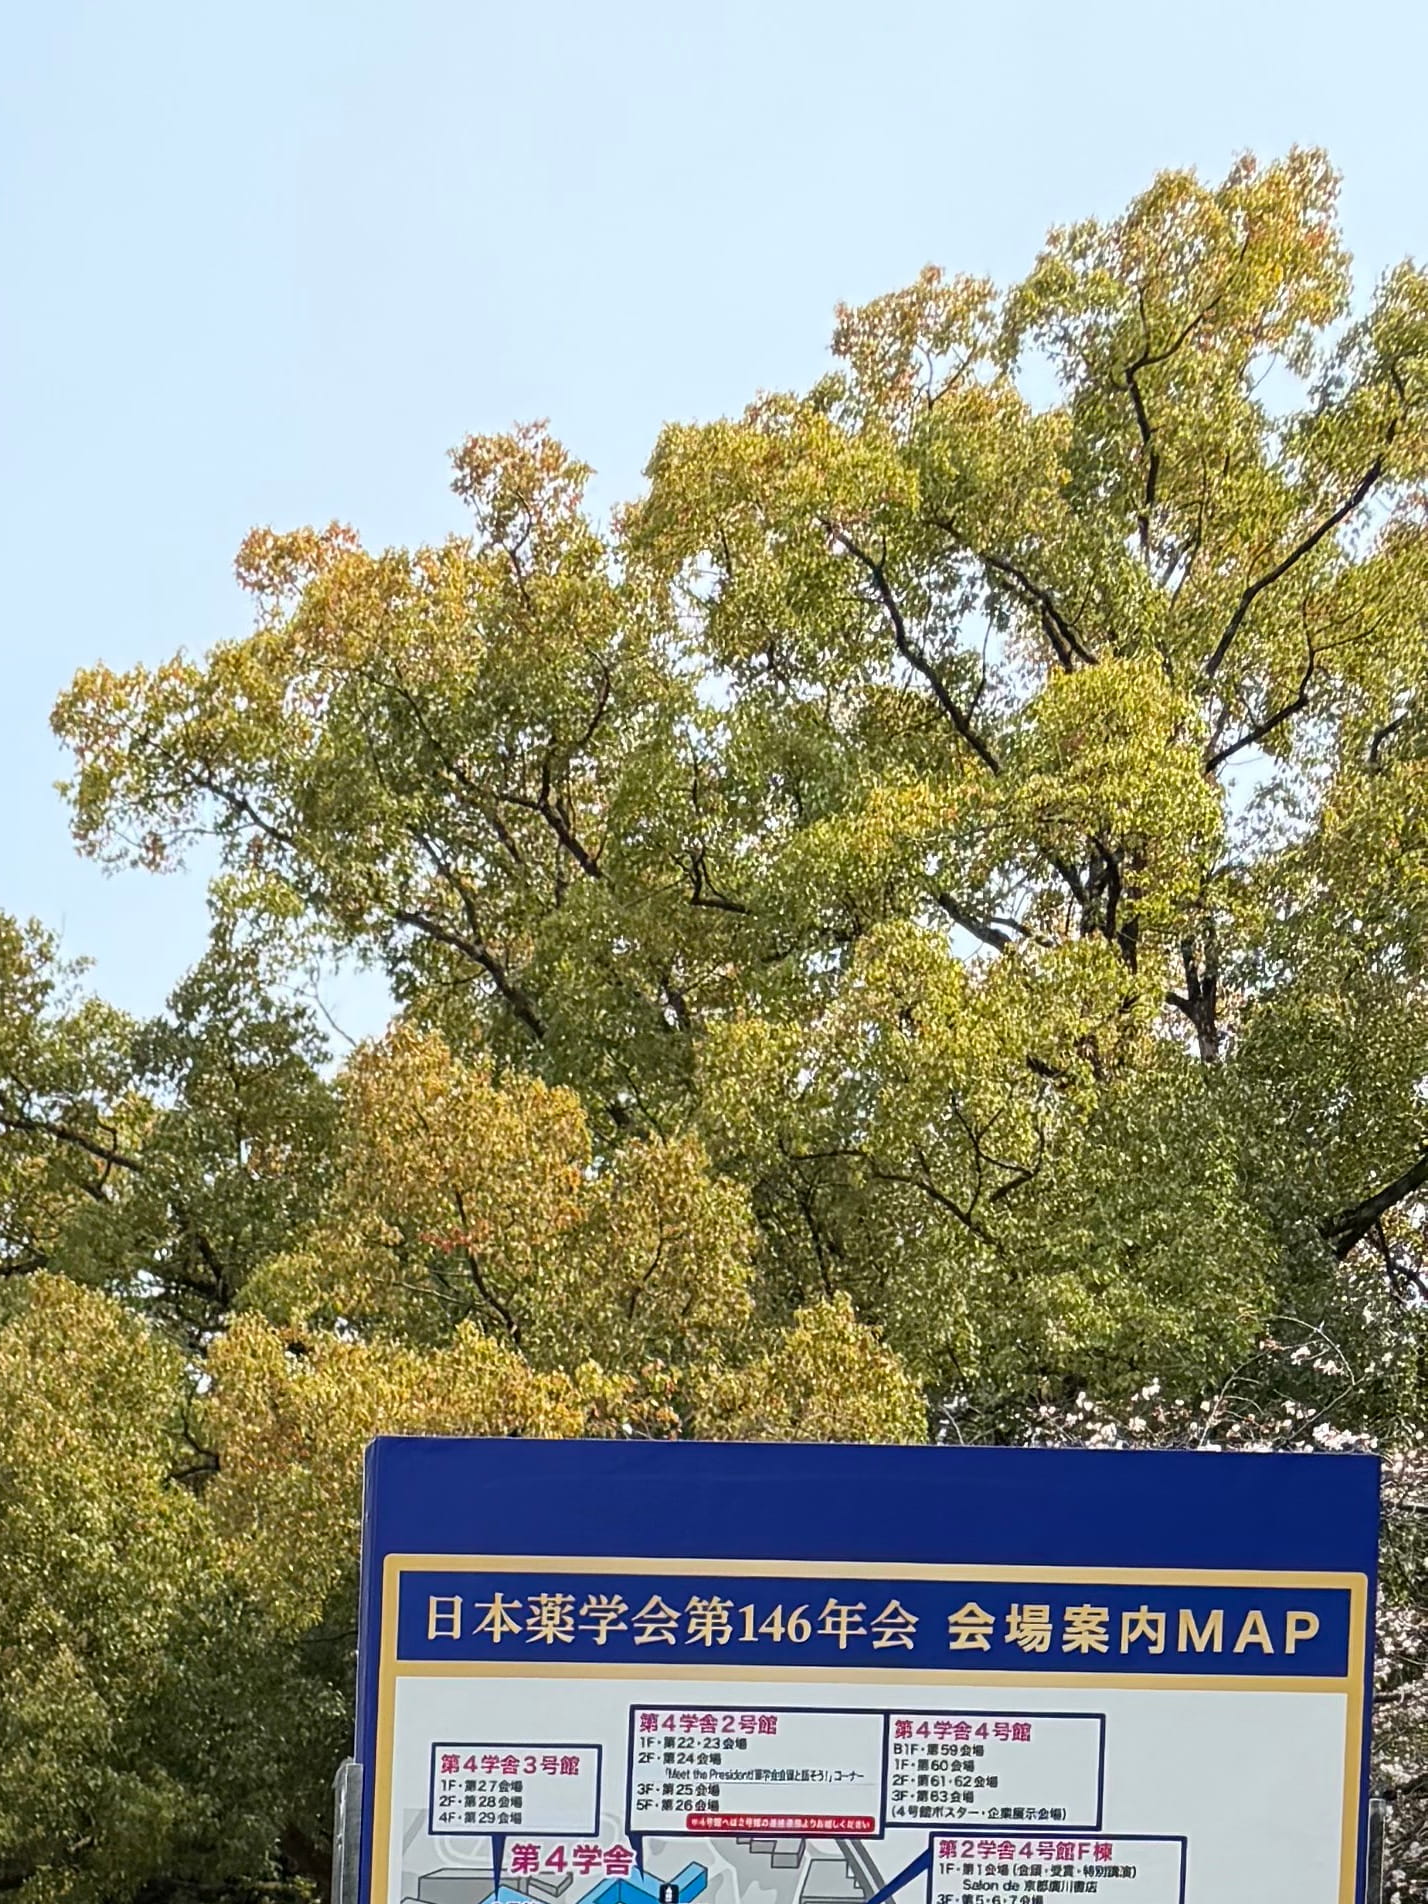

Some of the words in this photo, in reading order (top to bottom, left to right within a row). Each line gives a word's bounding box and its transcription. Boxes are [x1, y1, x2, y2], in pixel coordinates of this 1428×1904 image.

[427, 1591, 920, 1651] 日本薬学会第146年会
[947, 1600, 1321, 1656] 会場案内MAP
[639, 1713, 778, 1734] 第4学舎2号館
[894, 1720, 1032, 1742] 第4学舎4号館
[440, 1754, 580, 1776] 第4学舎3号館
[510, 1843, 634, 1877] 第4学舎
[938, 1839, 1113, 1862] 第2学舎4号館F棟
[962, 1880, 999, 1892] Salon
[1003, 1881, 1020, 1892] de
